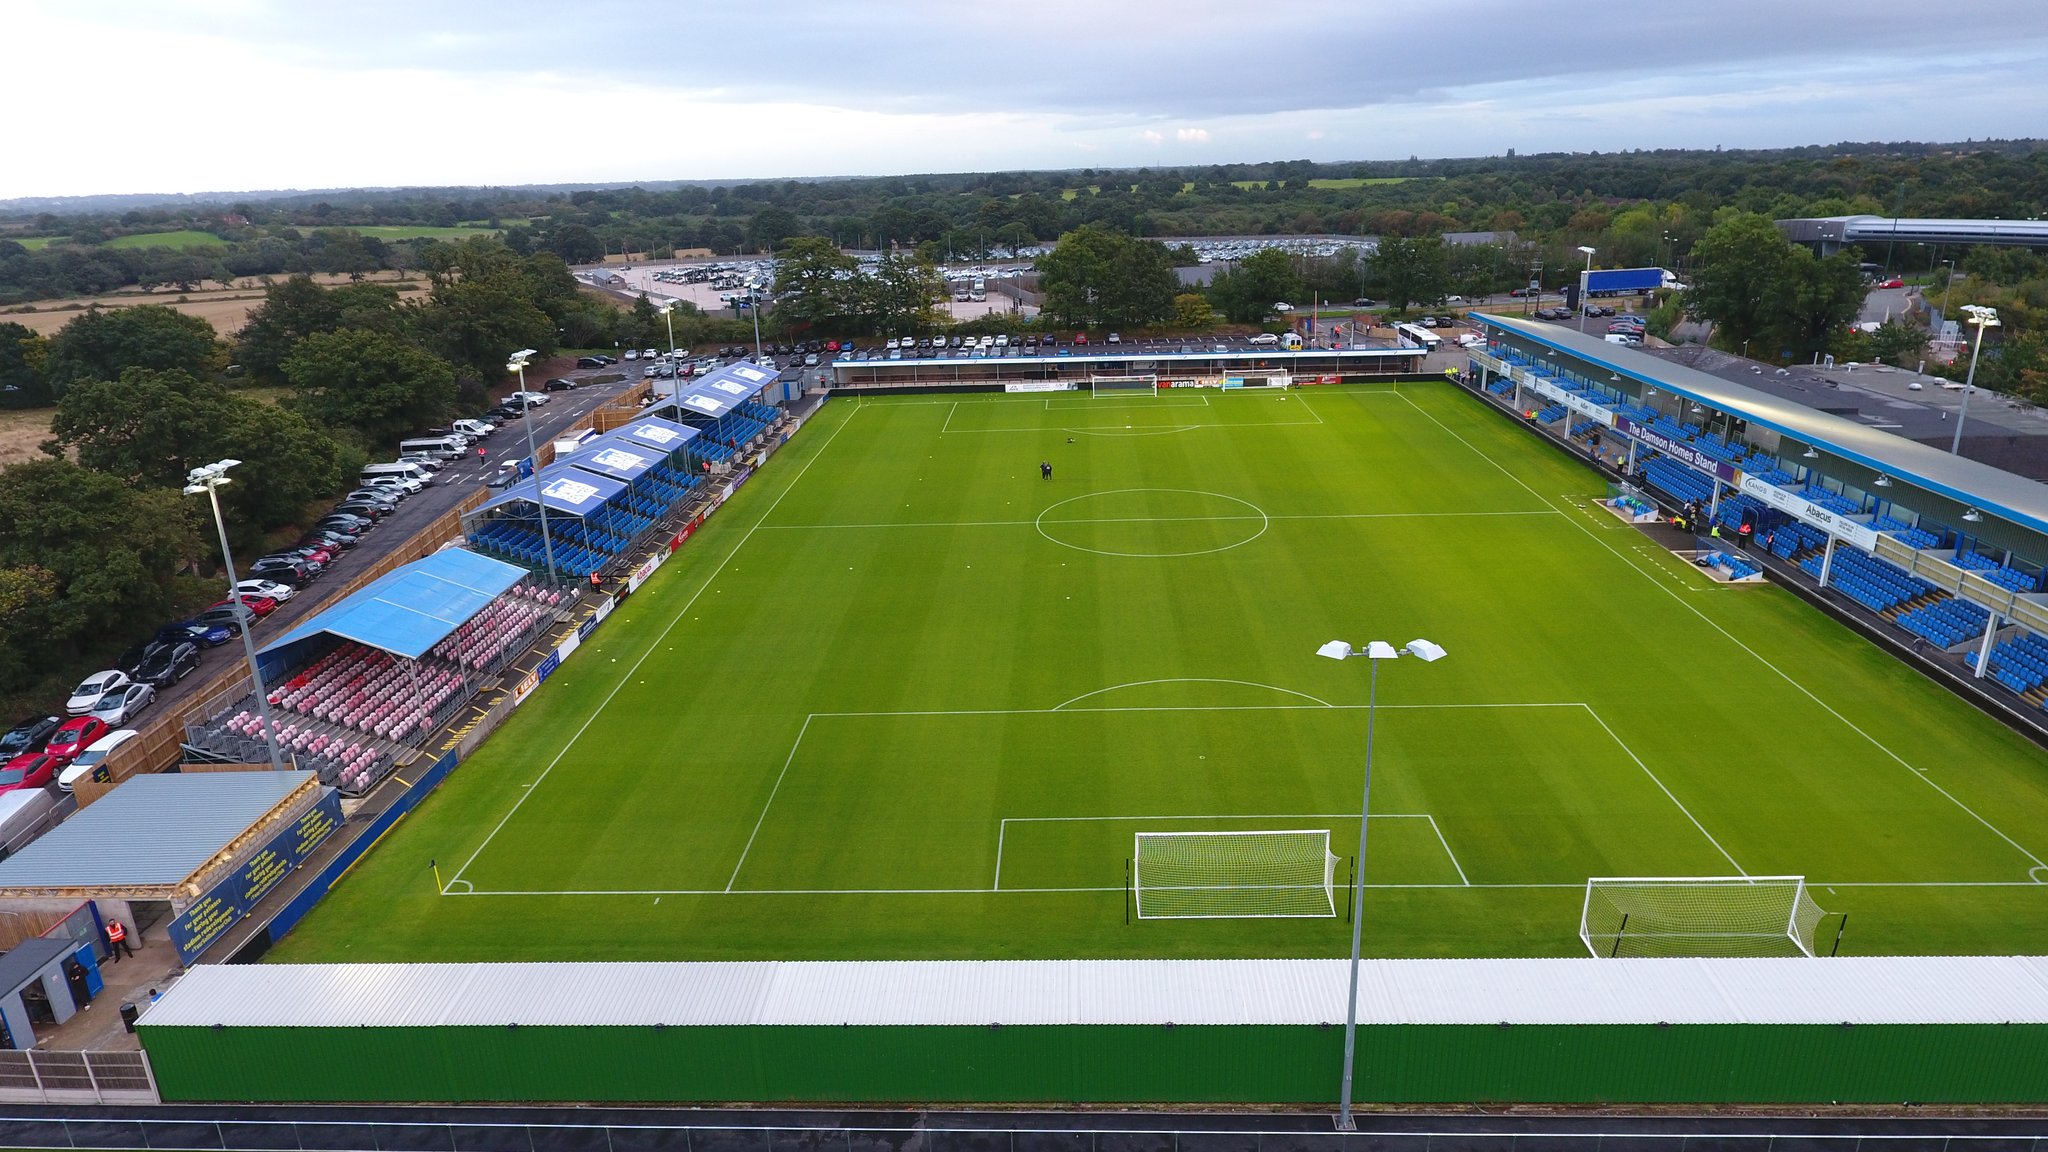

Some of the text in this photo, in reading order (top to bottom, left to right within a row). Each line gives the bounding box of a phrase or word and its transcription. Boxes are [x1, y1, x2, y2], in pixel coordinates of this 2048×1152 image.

[1629, 421, 1718, 473] The Damson Homes Stand
[1806, 504, 1832, 524] Abacus
[515, 672, 538, 699] KIELY
[249, 850, 268, 867] Thank you
[189, 897, 212, 917] Thank you
[192, 913, 203, 926] your
[203, 898, 221, 917] patience
[183, 906, 234, 951] stadium redevelopments
[194, 909, 218, 933] during your
